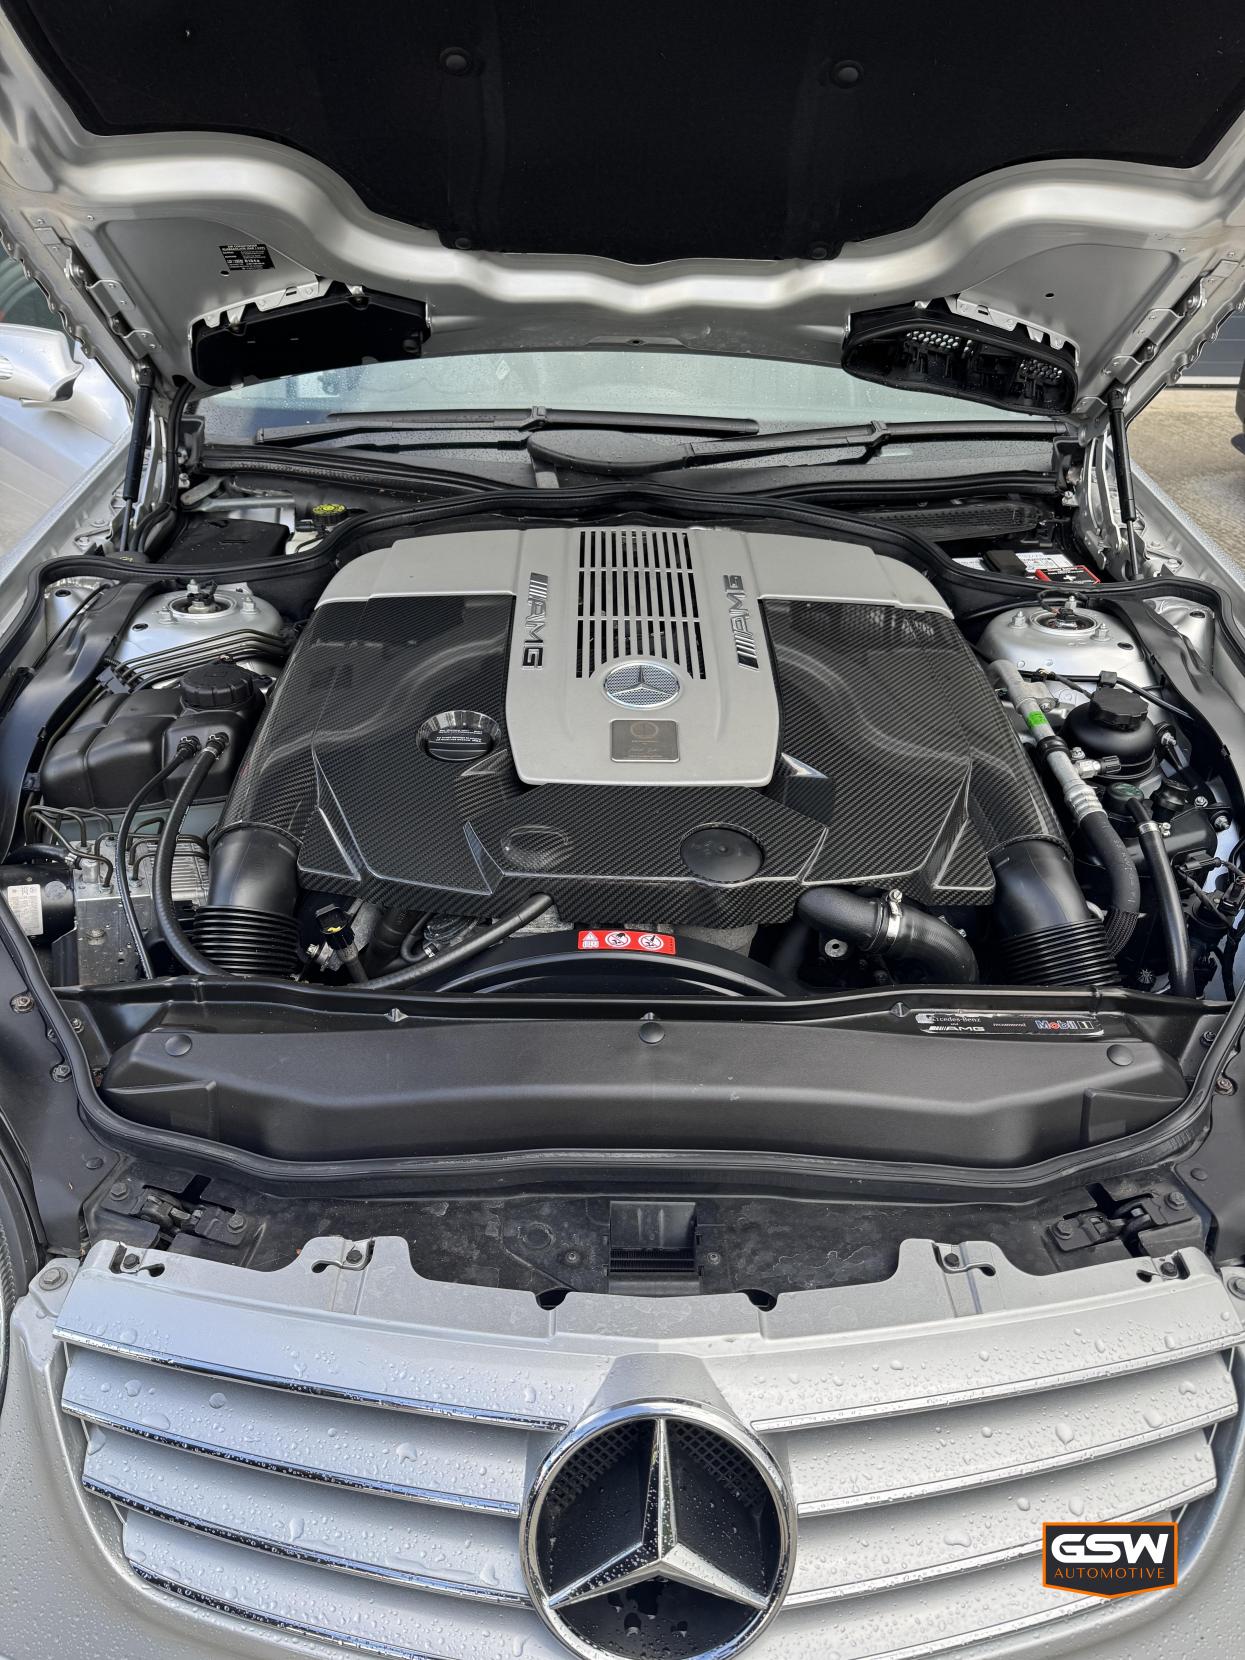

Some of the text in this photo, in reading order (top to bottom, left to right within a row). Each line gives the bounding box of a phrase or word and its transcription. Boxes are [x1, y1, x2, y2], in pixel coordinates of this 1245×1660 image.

[522, 598, 547, 668] AMG
[723, 574, 753, 639] AMG
[1035, 1020, 1078, 1030] Mobil
